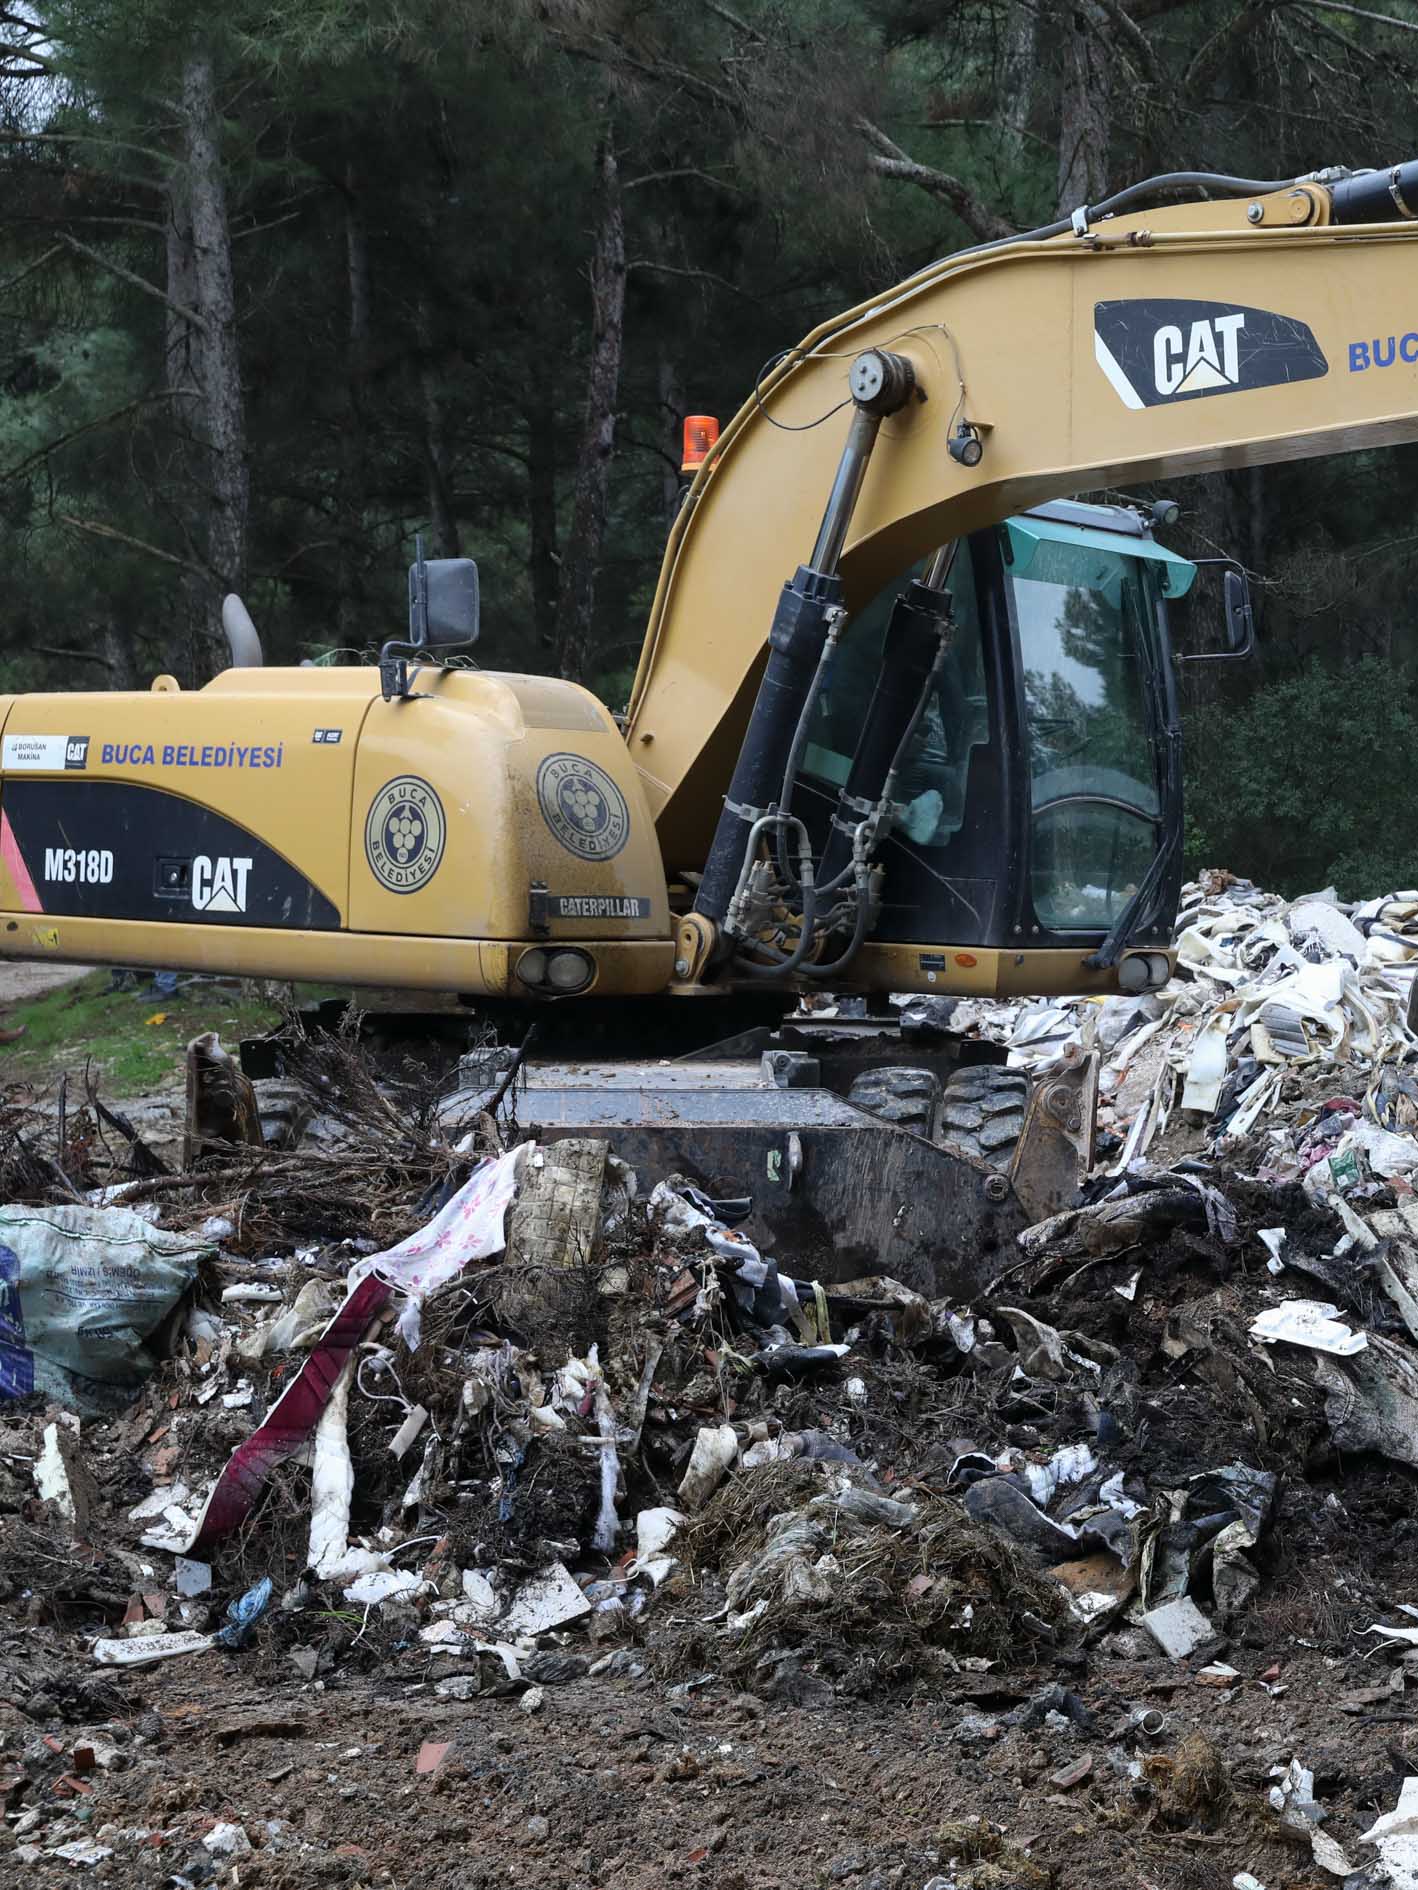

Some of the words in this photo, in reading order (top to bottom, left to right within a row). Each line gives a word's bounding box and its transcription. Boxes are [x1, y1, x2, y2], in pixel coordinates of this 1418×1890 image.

[1153, 313, 1245, 395] CAT
[66, 743, 87, 761] CAT
[101, 744, 155, 766] BUCA
[162, 741, 284, 768] BELEDİYESİ
[550, 763, 593, 781] BUCA
[387, 787, 427, 807] BUCA
[45, 848, 114, 884] M318D
[372, 840, 435, 882] BELEDİYESİ
[192, 855, 253, 912] CAT
[559, 898, 640, 917] CATERPILLAR
